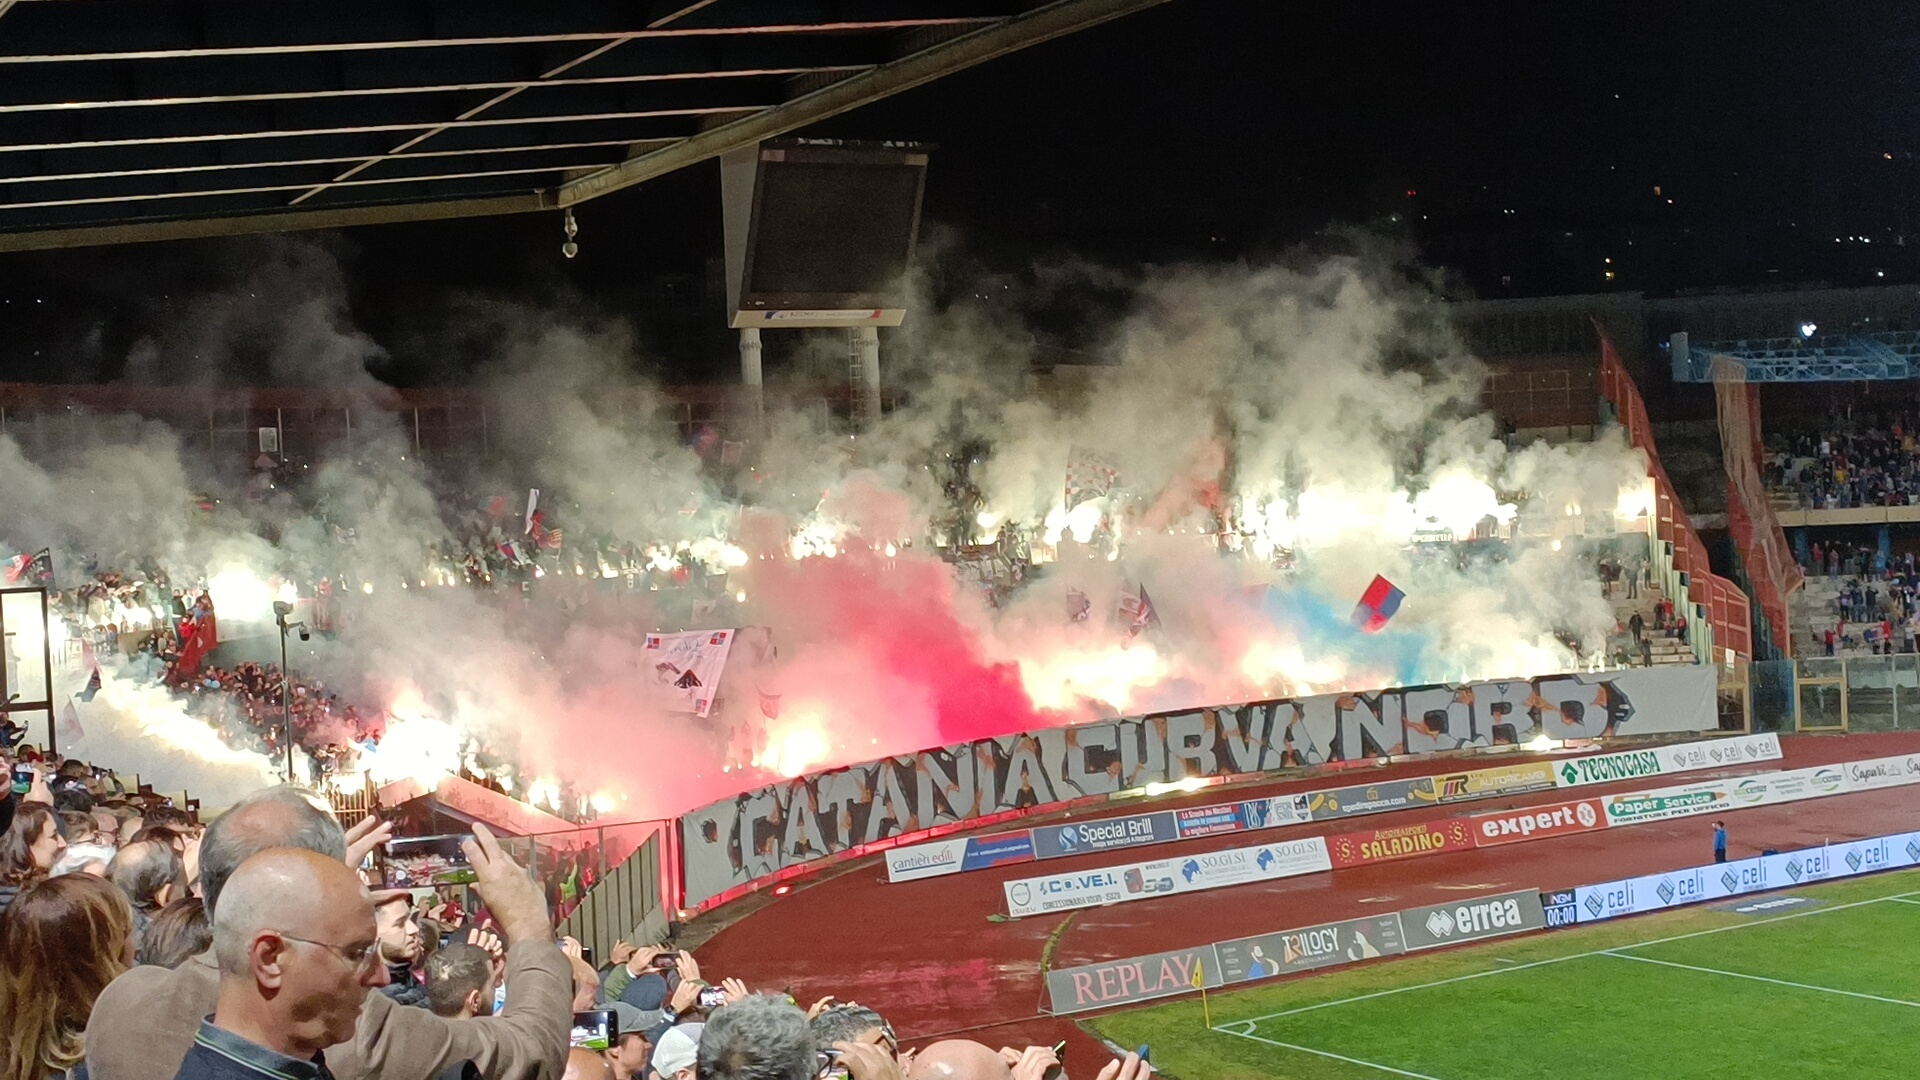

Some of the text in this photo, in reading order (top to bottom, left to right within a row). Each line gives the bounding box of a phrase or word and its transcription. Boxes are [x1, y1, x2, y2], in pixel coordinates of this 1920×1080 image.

[1688, 745, 1706, 763] celi
[1724, 741, 1742, 758] celi
[1760, 737, 1778, 753] celi
[734, 675, 1618, 879] CATANIA CURVA NORD
[1578, 751, 1661, 782] TECNOCASA
[1613, 794, 1711, 815] Paper Service
[1671, 808, 1690, 816] PER
[1693, 802, 1730, 813] UFFICIO
[1079, 820, 1126, 843] Special
[1128, 817, 1153, 836] Brill
[1482, 806, 1575, 837] expert
[892, 852, 930, 870] cantieri
[932, 845, 953, 863] edili
[1360, 831, 1445, 859] SALADINO
[1865, 839, 1889, 864] celi
[1742, 859, 1767, 885] celi
[1806, 848, 1829, 874] celi
[1608, 881, 1634, 908] celi
[1679, 869, 1704, 896] celi
[1547, 906, 1575, 926] 00:00
[1282, 928, 1339, 963] TRILOGY
[1072, 953, 1193, 1005] REPLAY
